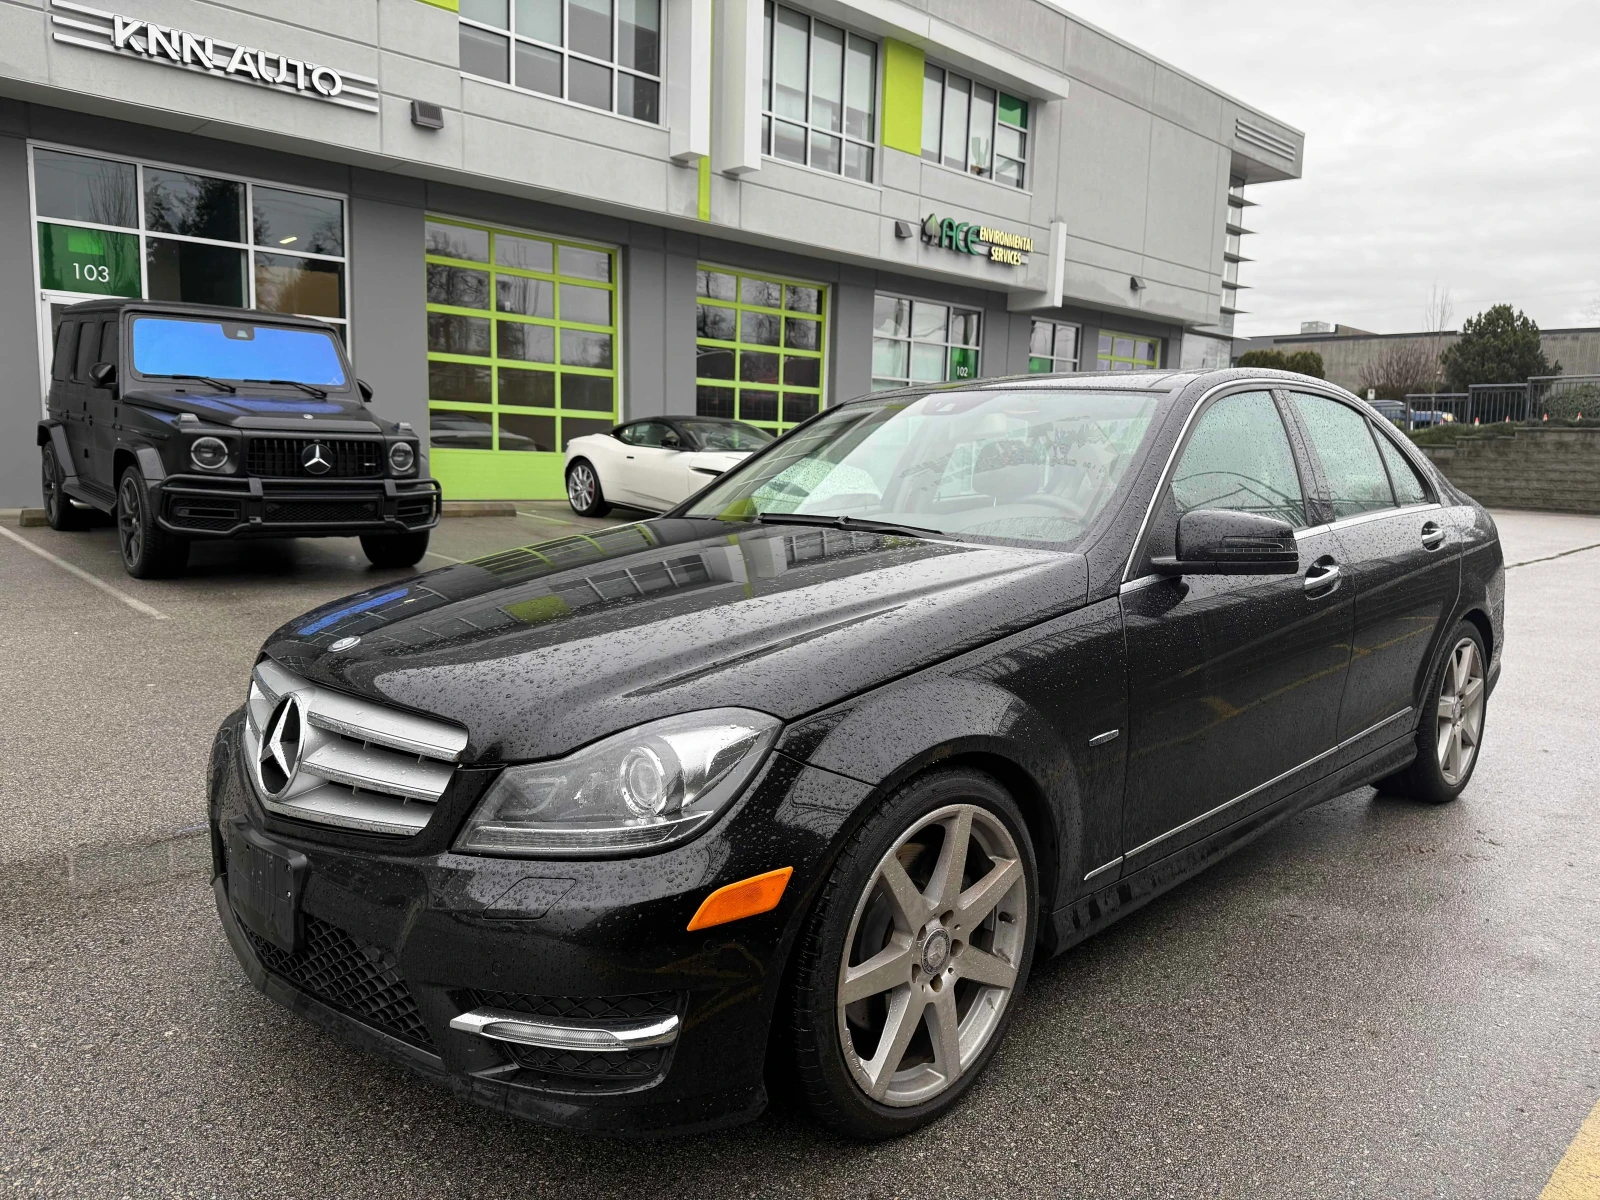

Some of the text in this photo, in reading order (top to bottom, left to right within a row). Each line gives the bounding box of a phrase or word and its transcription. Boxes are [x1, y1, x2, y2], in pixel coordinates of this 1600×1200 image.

[112, 15, 343, 96] KNN AUTO
[940, 217, 980, 256] ACE
[979, 226, 1034, 252] ENVIRONMENTAL
[991, 246, 1022, 266] SERVICES
[72, 262, 109, 283] 103
[956, 365, 969, 377] 102
